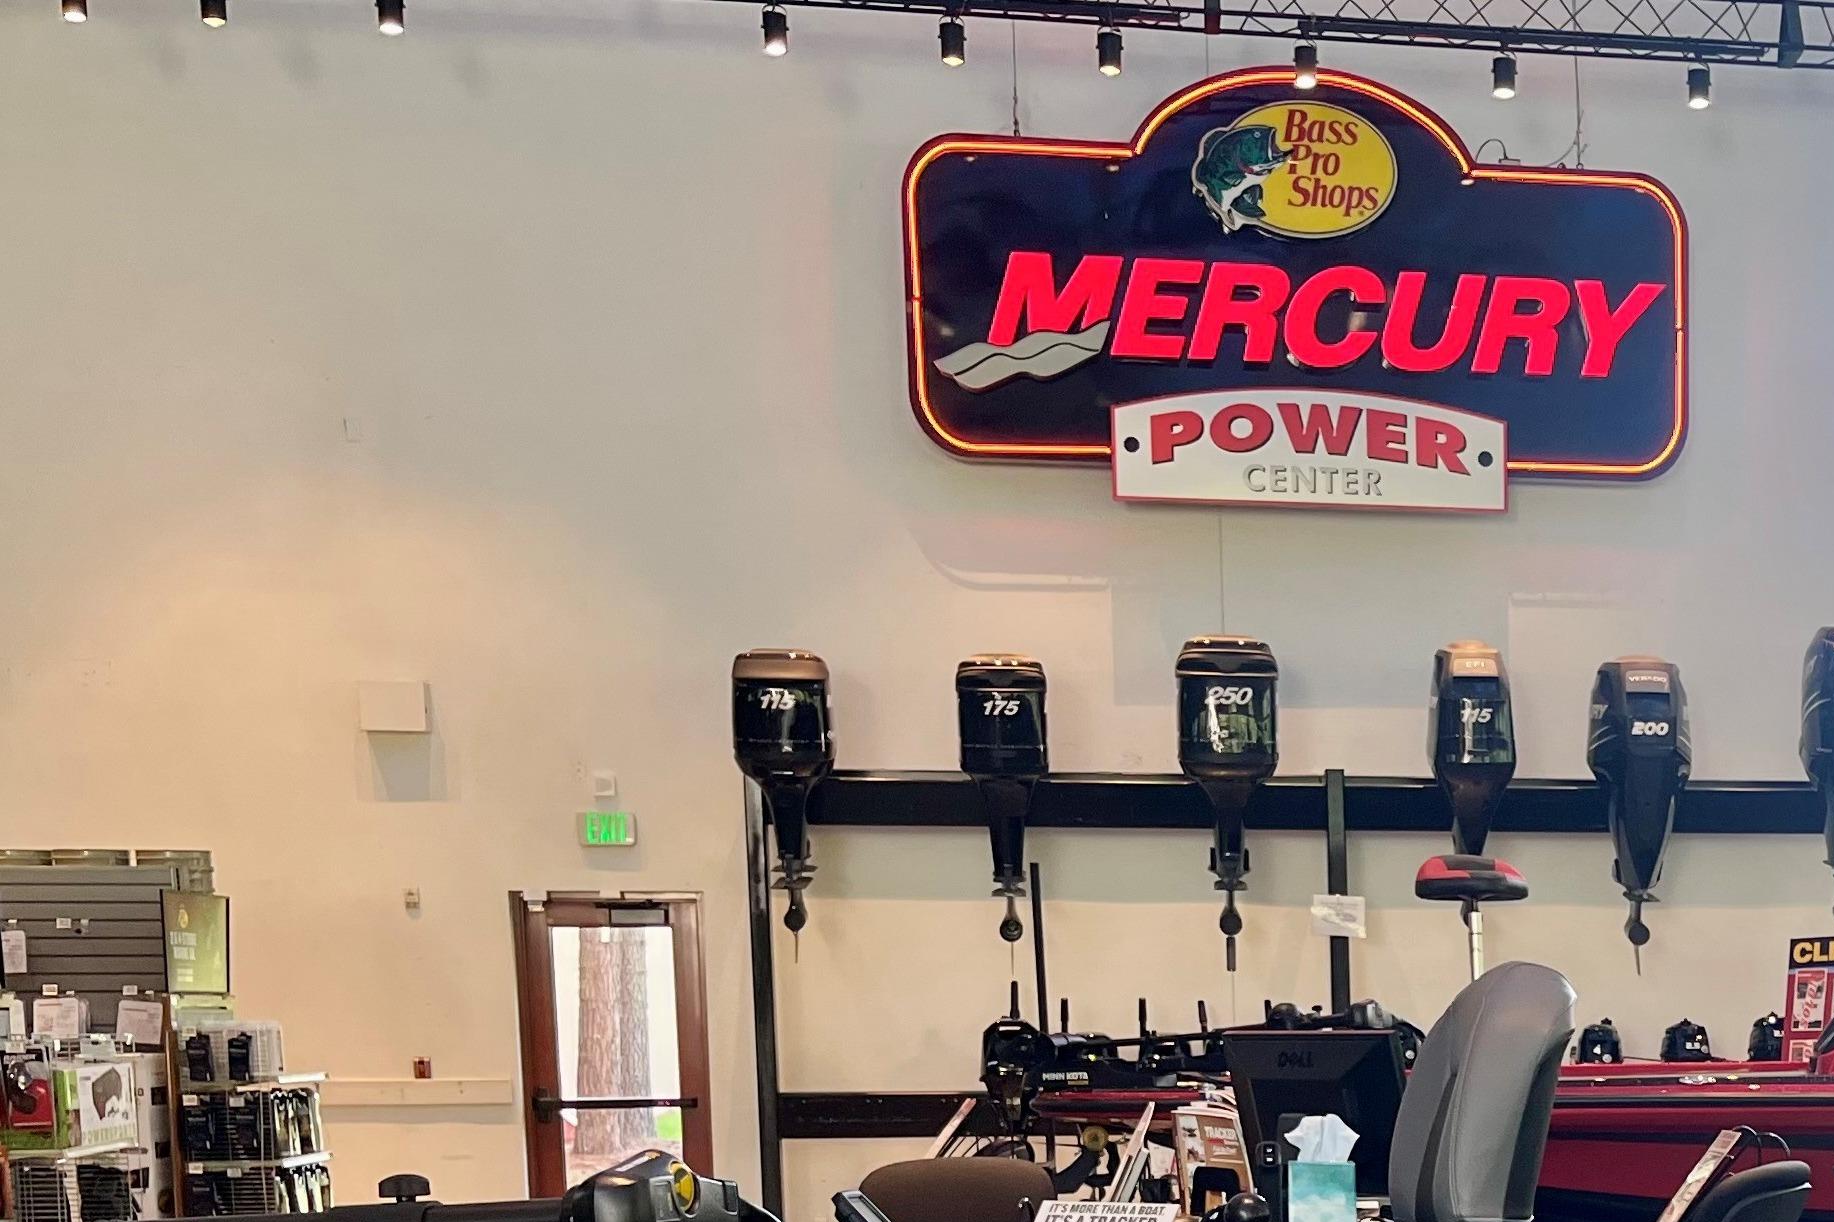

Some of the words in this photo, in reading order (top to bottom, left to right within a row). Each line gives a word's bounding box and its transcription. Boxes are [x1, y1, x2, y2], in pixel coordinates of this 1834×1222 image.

[1282, 109, 1359, 146] Bass
[1286, 144, 1340, 176] Pro
[1287, 176, 1379, 217] Shops
[988, 252, 1667, 378] MERCURY
[1150, 403, 1472, 476] POWER
[1243, 463, 1383, 496] CENTER
[983, 700, 1020, 716] 175
[1205, 686, 1253, 705] 250
[1631, 721, 1669, 736] 200
[586, 812, 628, 845] EXIT
[1048, 1203, 1069, 1213] IT'S
[1070, 1204, 1099, 1214] MORE
[1100, 1204, 1129, 1215] THAN
[1129, 1205, 1136, 1215] A
